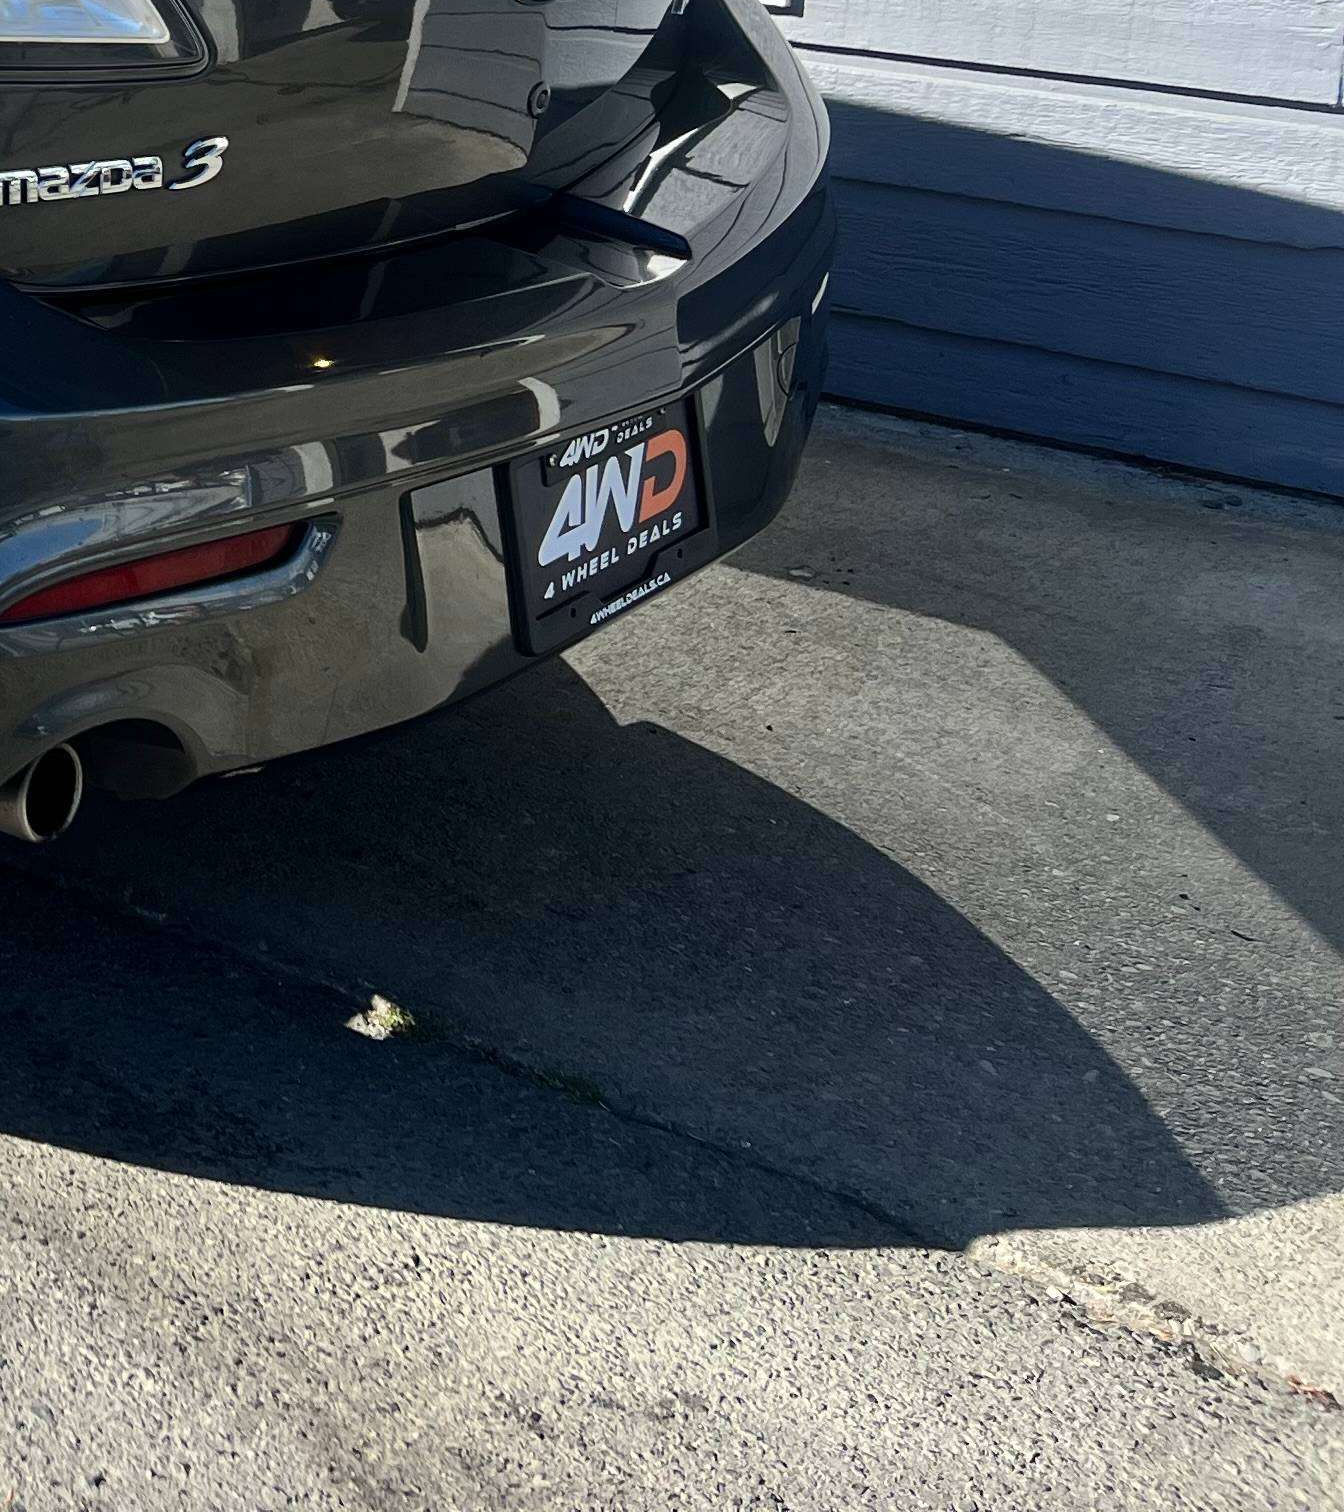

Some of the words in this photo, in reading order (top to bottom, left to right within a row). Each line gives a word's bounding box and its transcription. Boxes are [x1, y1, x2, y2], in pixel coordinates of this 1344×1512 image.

[168, 136, 230, 190] 3
[538, 429, 687, 567] 4WD
[544, 581, 555, 600] 4
[561, 551, 620, 592] WHEEL
[627, 512, 682, 555] DEALS
